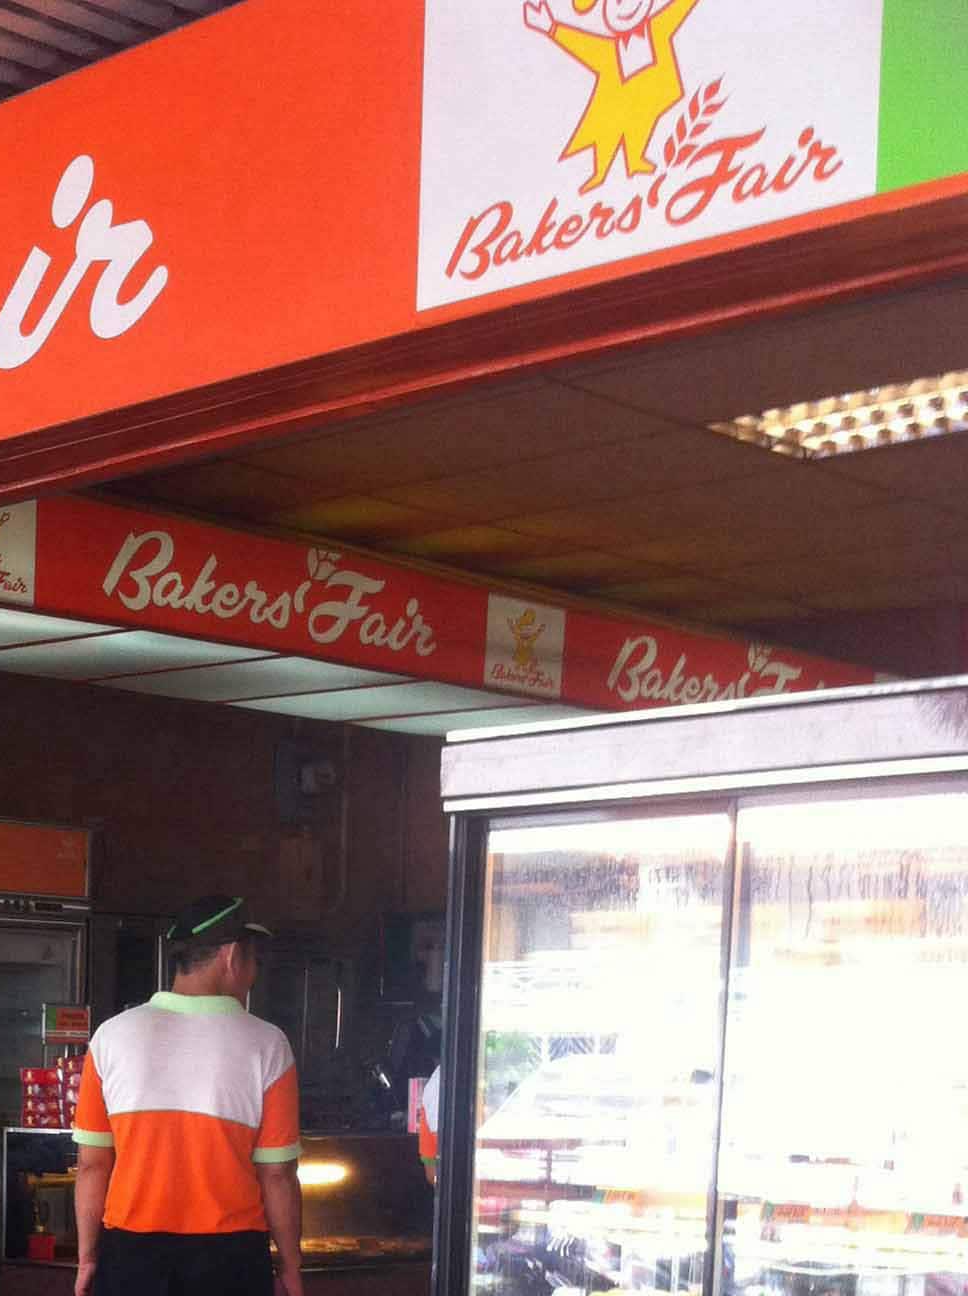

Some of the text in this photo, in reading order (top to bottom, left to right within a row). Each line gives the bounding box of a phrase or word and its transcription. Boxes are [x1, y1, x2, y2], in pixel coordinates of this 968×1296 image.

[445, 126, 843, 281] Bakers' Fair
[102, 530, 436, 657] Bakers' Fair
